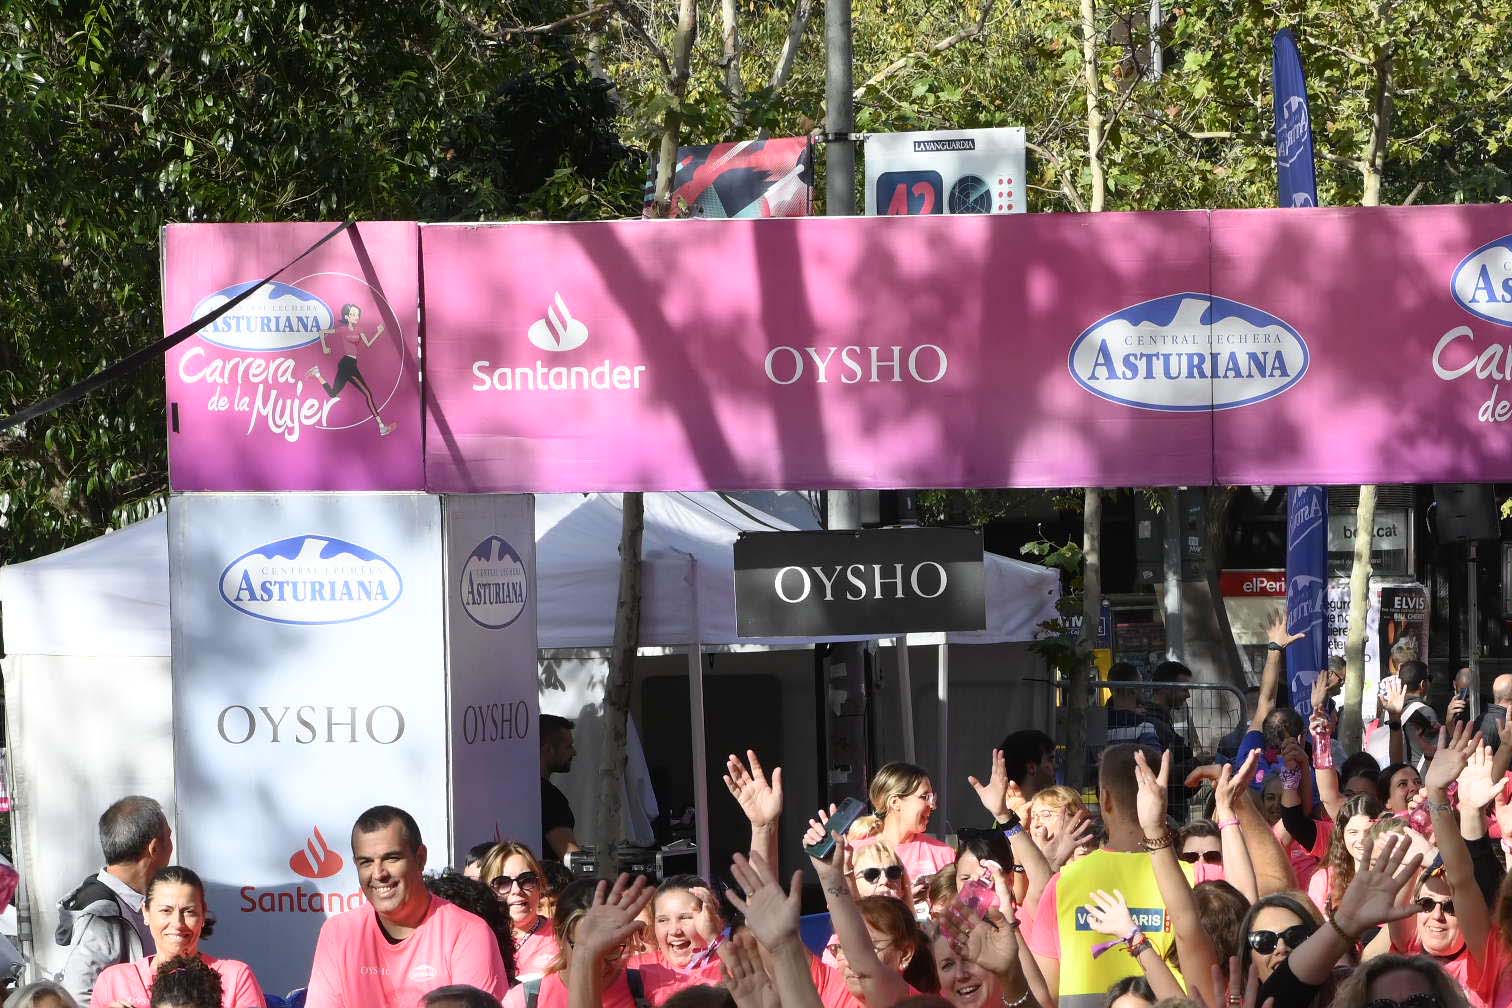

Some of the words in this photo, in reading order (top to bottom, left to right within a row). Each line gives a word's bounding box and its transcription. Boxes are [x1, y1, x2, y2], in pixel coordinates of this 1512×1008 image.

[925, 139, 974, 151] VANGUARDIA
[1124, 333, 1200, 345] CENTRAL
[1205, 331, 1282, 344] LECHERA
[178, 347, 296, 384] Carrera
[473, 360, 647, 391] Santander
[764, 344, 949, 384] OYSHO
[1088, 338, 1290, 381] ASTURIANA
[207, 386, 229, 412] de
[234, 386, 250, 412] la
[246, 380, 341, 442] Mujer
[1478, 384, 1512, 423] de
[234, 569, 389, 602] ASTURIANA
[465, 569, 524, 606] ASTURIANA
[774, 561, 947, 603] OYSHO
[1394, 596, 1425, 609] ELVIS
[217, 703, 405, 745] OYSHO
[463, 699, 529, 745] OYSHO
